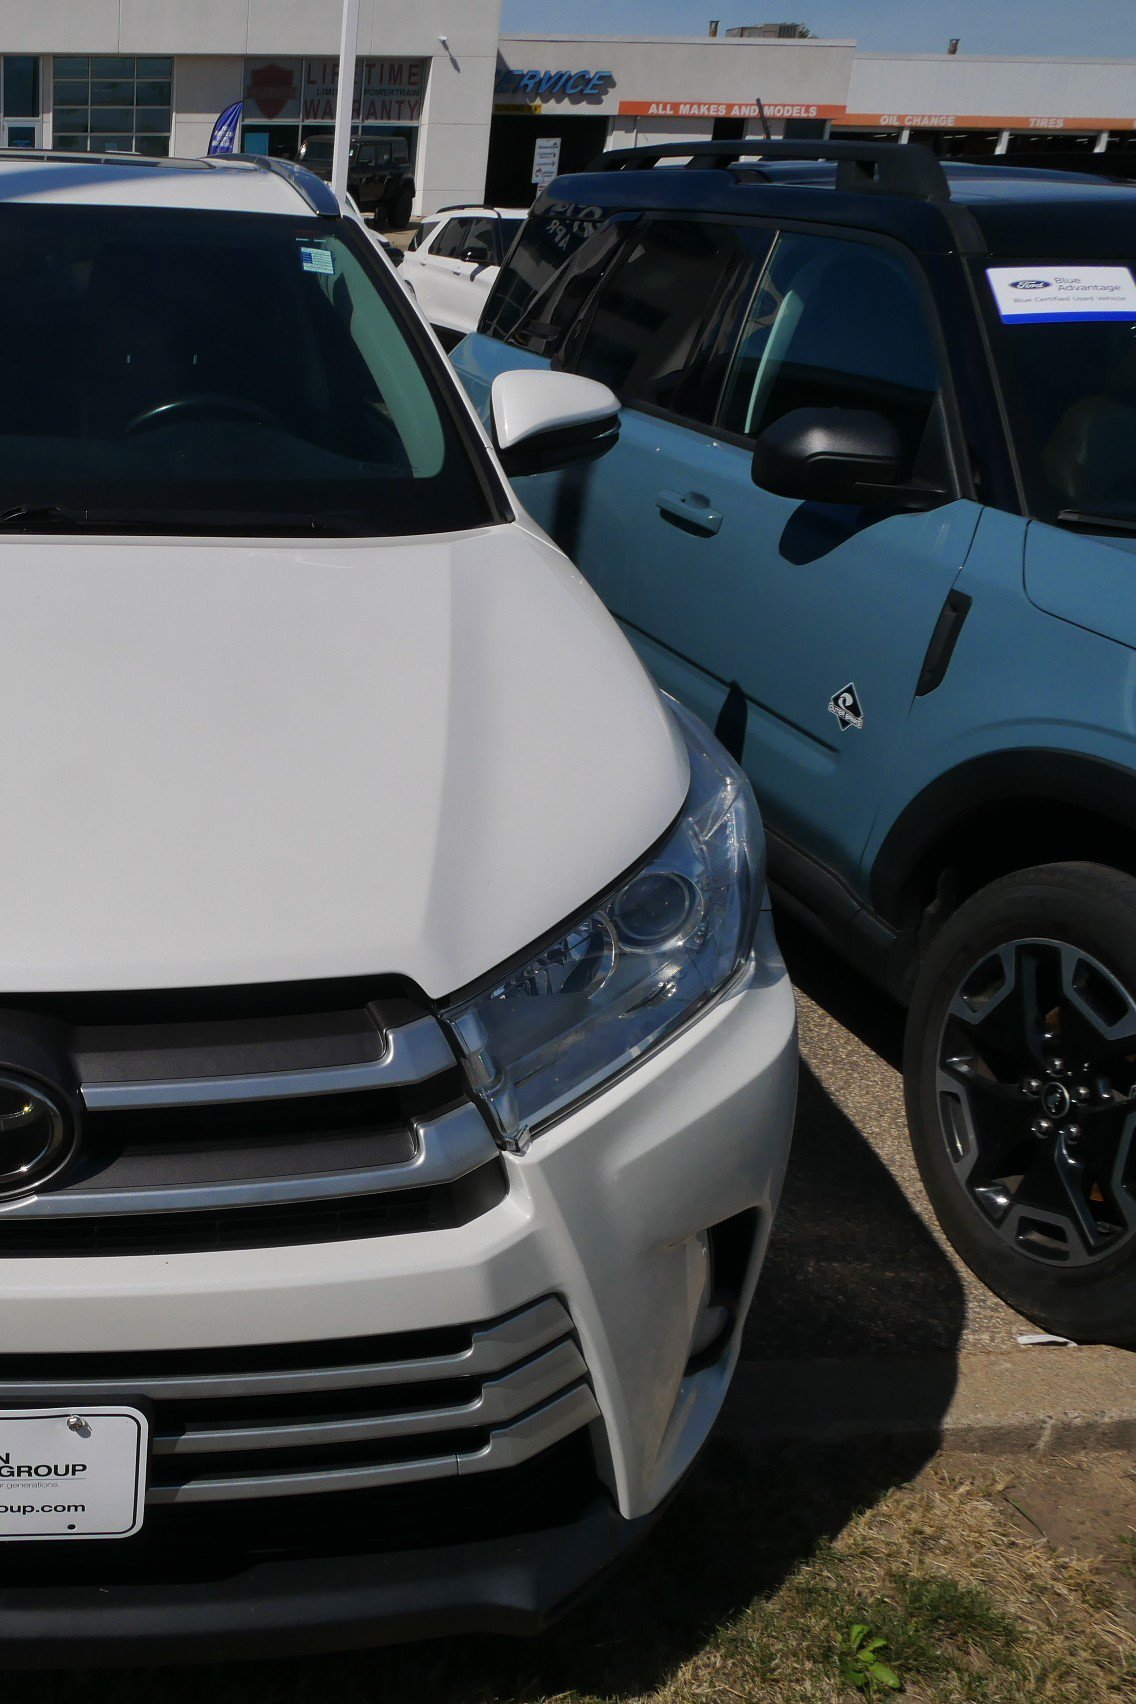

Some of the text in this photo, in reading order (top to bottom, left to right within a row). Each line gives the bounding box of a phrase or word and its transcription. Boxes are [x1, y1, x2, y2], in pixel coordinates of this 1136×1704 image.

[306, 62, 420, 86] LIFTIME
[495, 70, 612, 94] ERVICE
[364, 88, 420, 97] POWERTRAIN
[304, 99, 420, 121] WARANTY
[648, 103, 818, 118] ALL MAKES AND MODELS
[880, 115, 956, 127] OIL CHANGE
[1028, 118, 1064, 129] TIRES
[1057, 285, 1122, 293] Advantage
